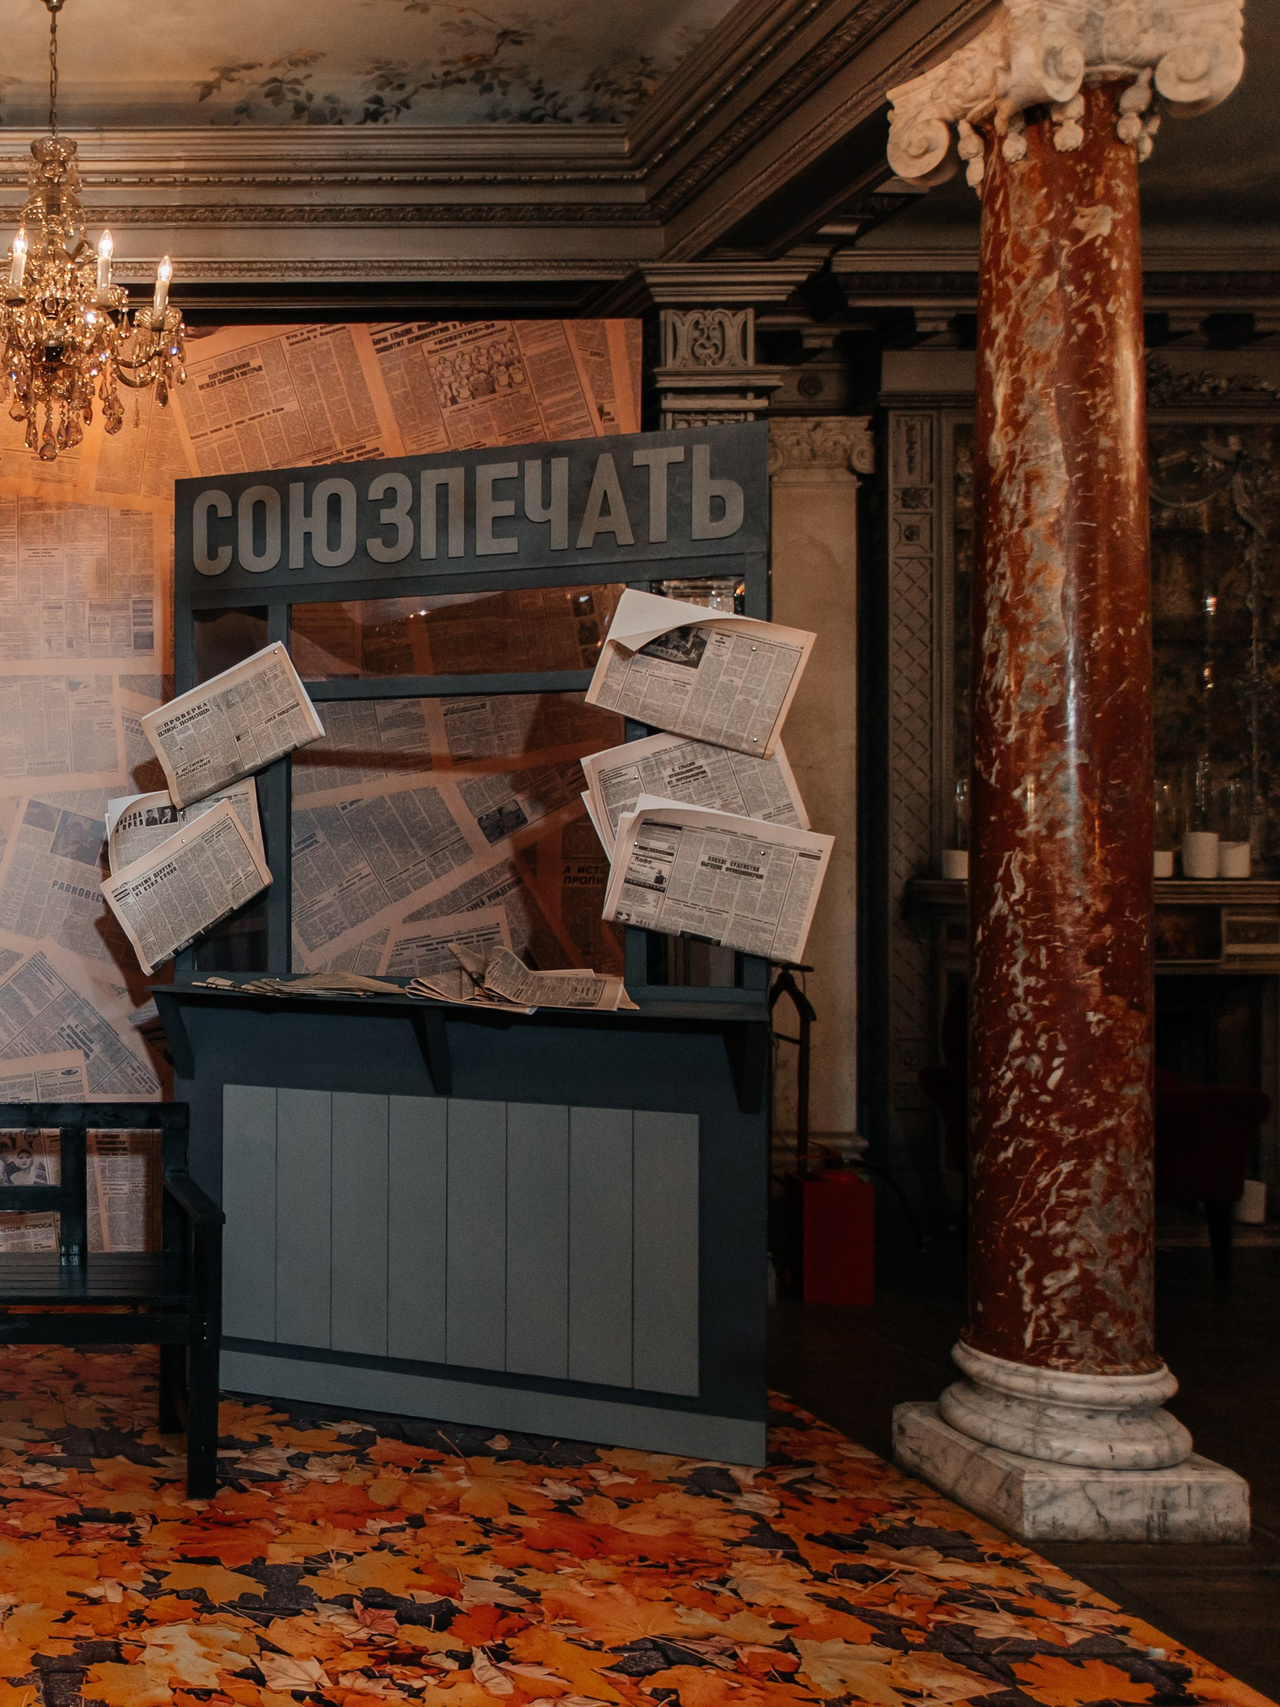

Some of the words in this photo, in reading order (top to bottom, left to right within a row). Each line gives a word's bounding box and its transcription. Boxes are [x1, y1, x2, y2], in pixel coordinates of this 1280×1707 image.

[192, 444, 744, 577] СОЮЗПЕЧАТЬ
[157, 724, 179, 738] ПЛЮС
[179, 708, 211, 727] ПОМОЩЬ
[163, 702, 208, 728] ПРОВЕРКА
[115, 811, 143, 829] ВЕЗДА
[24, 1222, 54, 1231] СПРОСА
